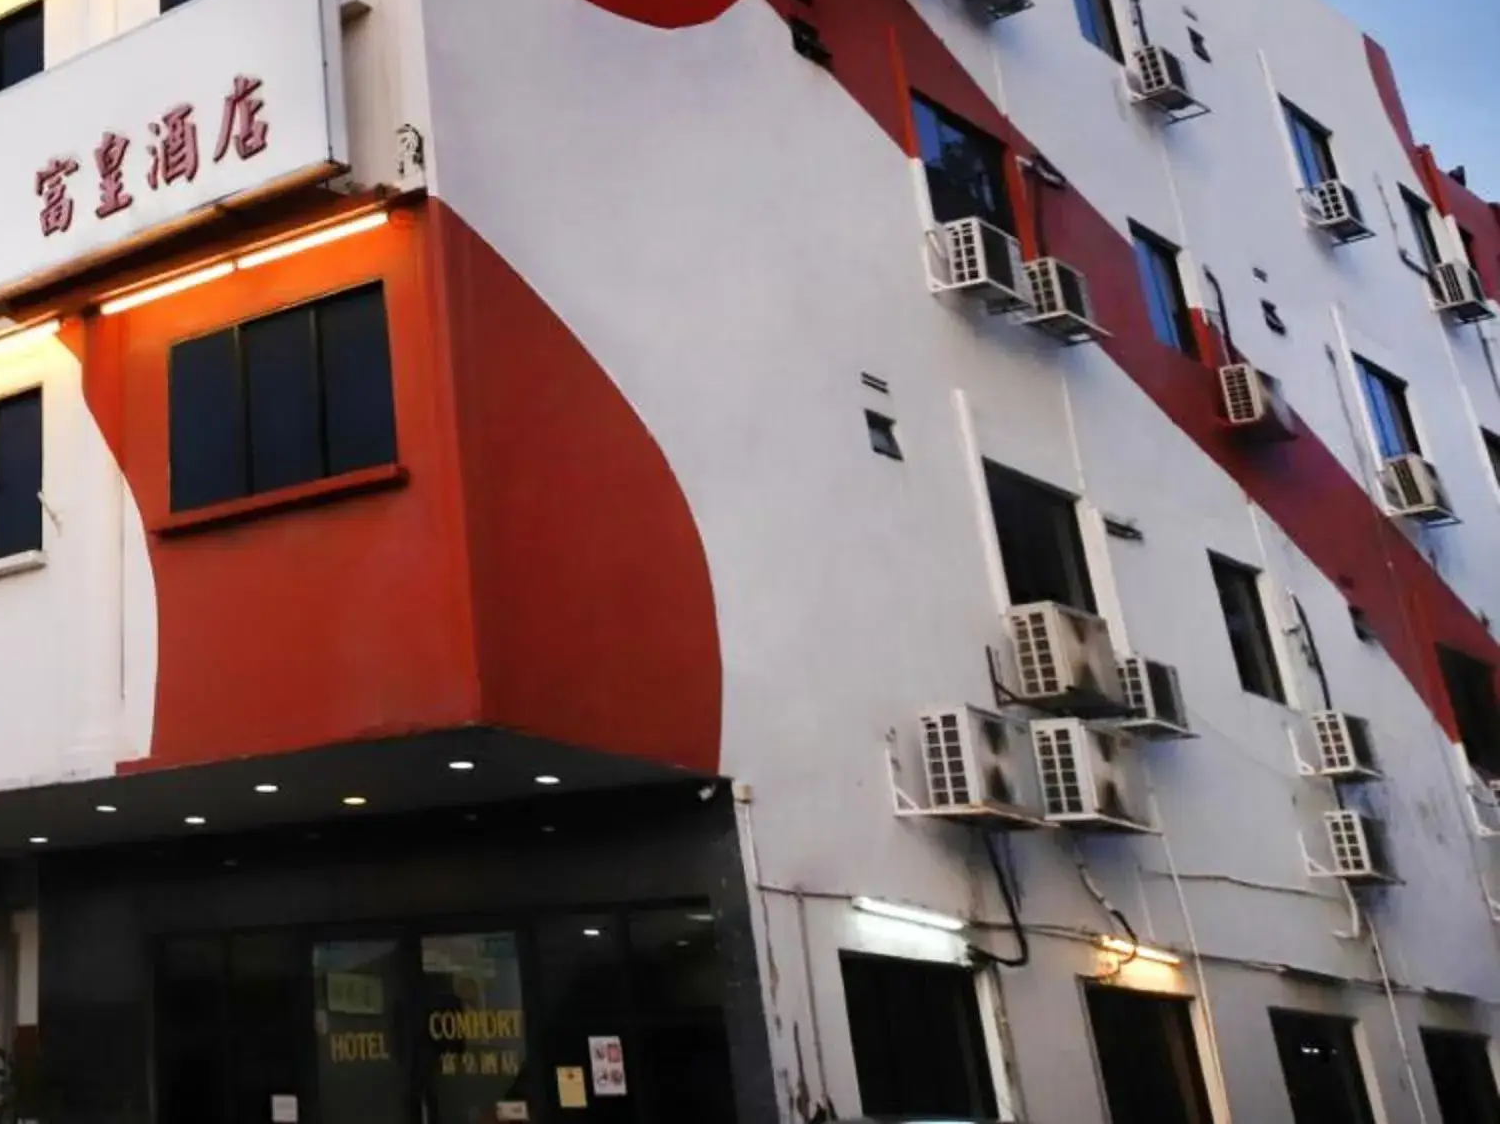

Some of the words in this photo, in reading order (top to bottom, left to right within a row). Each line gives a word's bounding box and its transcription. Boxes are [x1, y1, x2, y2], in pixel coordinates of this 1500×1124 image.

[35, 73, 269, 237] 富皇酒店
[330, 1031, 390, 1064] HOTEL
